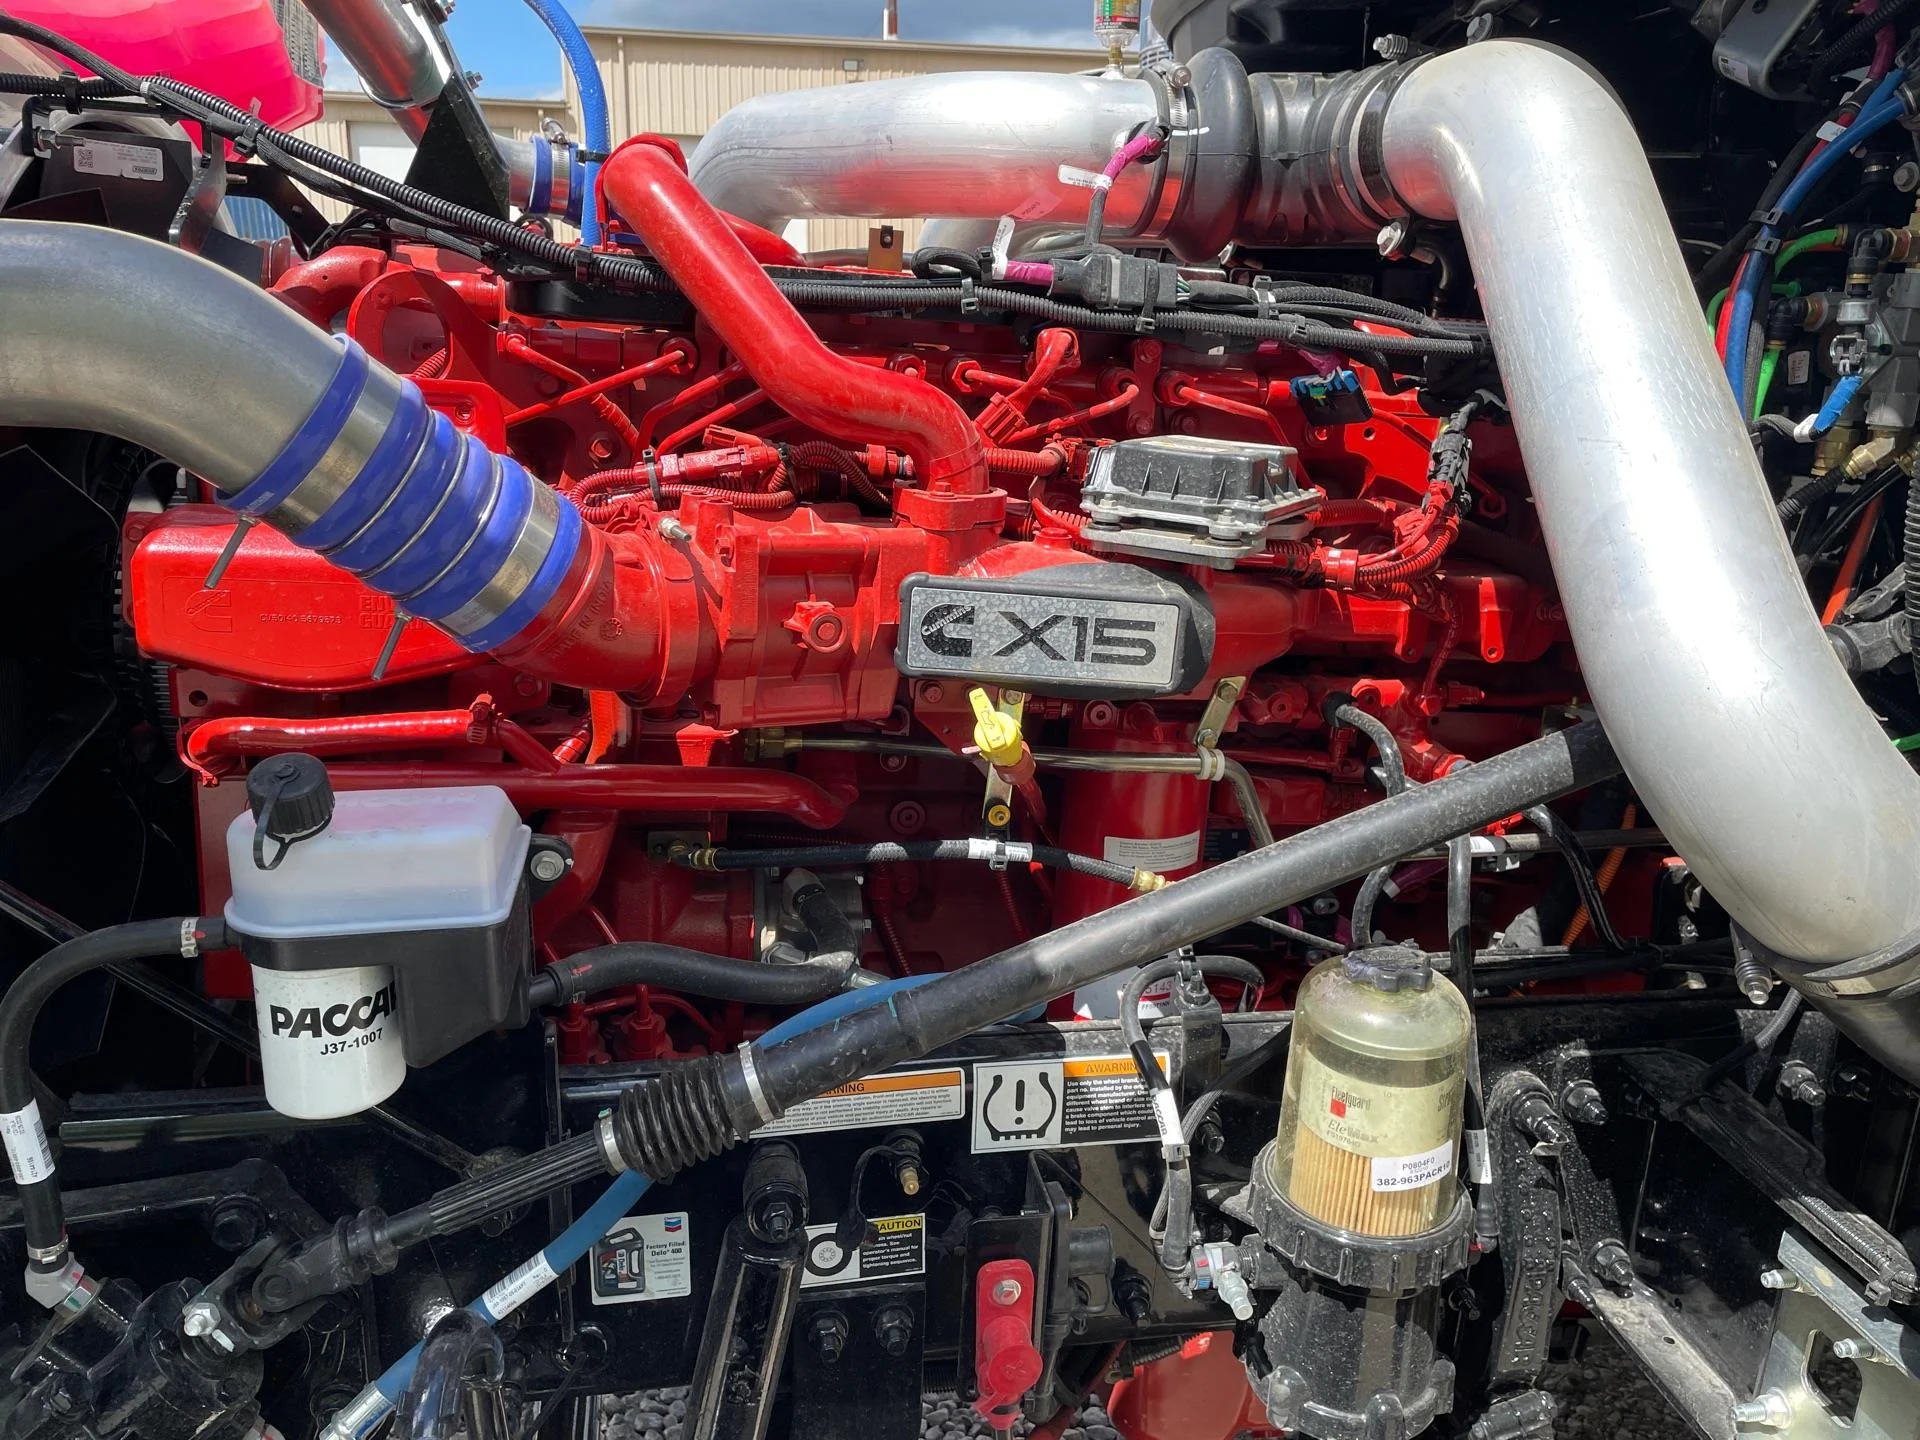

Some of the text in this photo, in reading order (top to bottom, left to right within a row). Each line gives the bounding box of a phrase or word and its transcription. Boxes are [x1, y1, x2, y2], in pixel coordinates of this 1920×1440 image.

[921, 603, 973, 637] Cummins
[992, 611, 1156, 666] X15
[320, 1027, 383, 1056] J37-1007
[1095, 1062, 1138, 1074] WARNIN
[1151, 1094, 1168, 1136] PACCAR
[1376, 1160, 1451, 1187] 382-963PACR10
[862, 1248, 889, 1256] operator's
